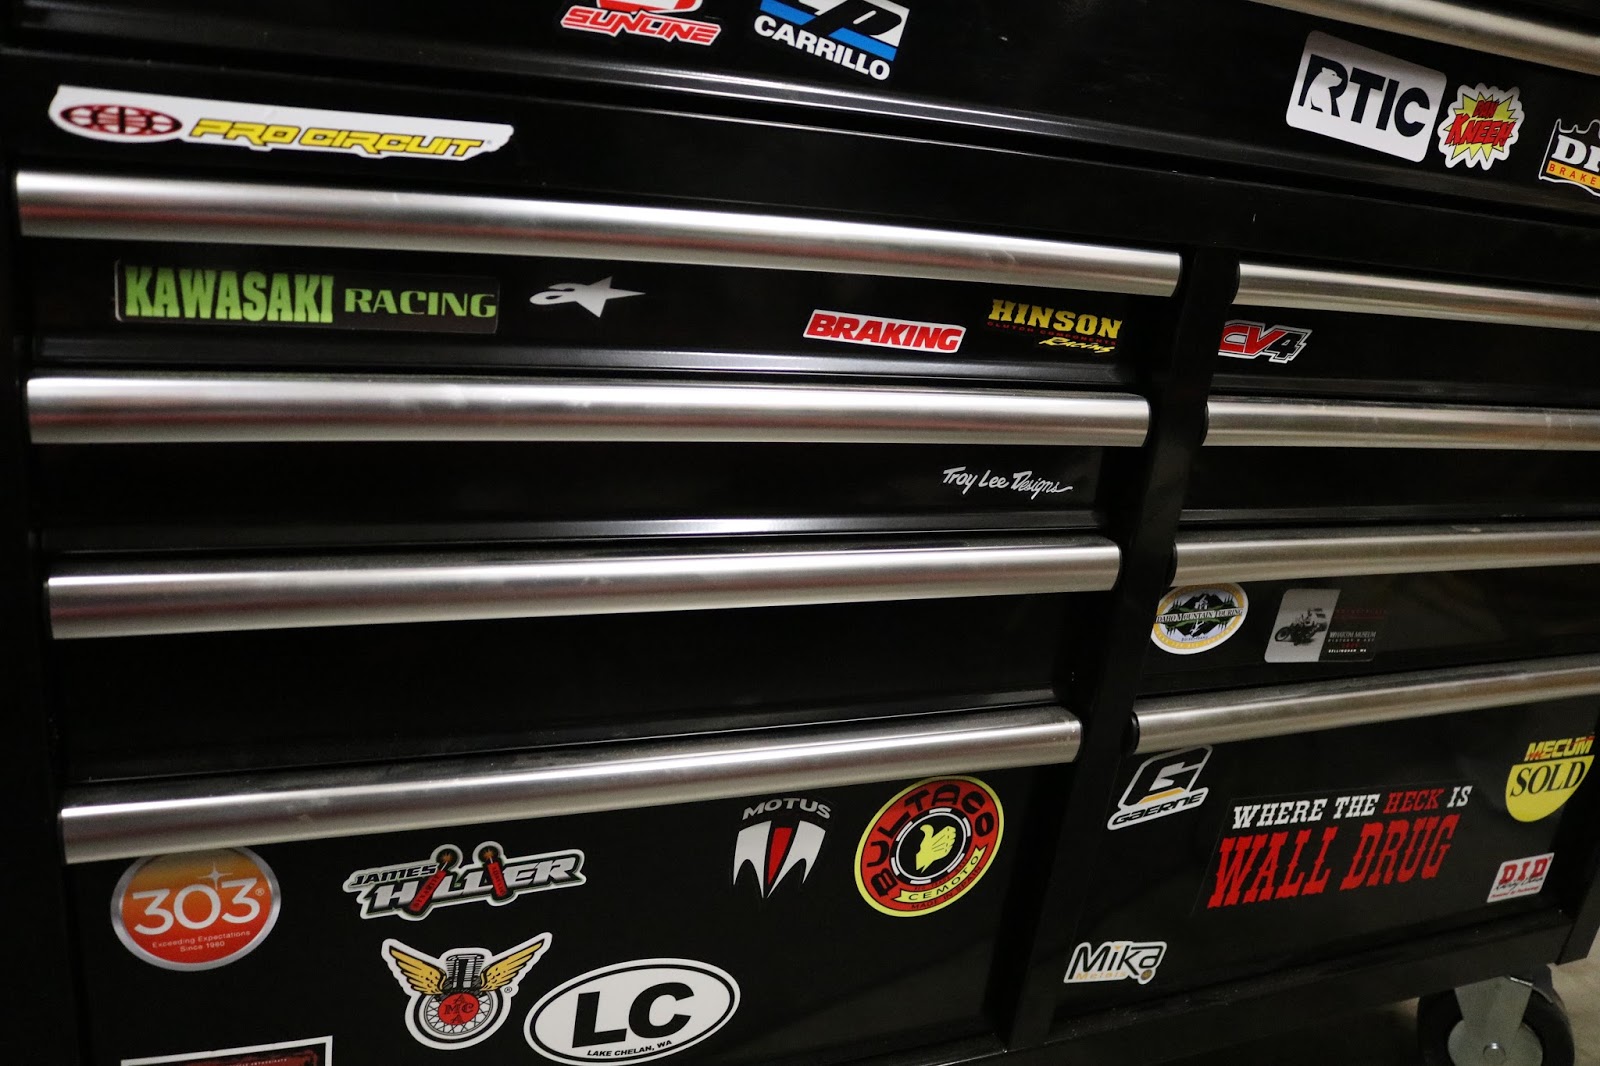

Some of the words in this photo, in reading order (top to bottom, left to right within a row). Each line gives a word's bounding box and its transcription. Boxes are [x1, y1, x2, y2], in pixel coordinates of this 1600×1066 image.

[562, 5, 722, 44] SUNLINE
[753, 14, 891, 81] CARRILLO
[1297, 53, 1431, 138] RTIC
[190, 117, 301, 146] PRO
[299, 126, 484, 157] CIRCUIT
[1444, 112, 1517, 148] KNEEN
[124, 266, 334, 324] KAWASAKI
[344, 287, 497, 318] RACING
[806, 313, 963, 351] BRAKING
[986, 320, 1035, 333] CLUTCH
[1039, 328, 1117, 346] COMPONENTS
[987, 298, 1123, 340] HINSON
[1038, 336, 1116, 354] Racing
[942, 466, 979, 495] Troy
[978, 469, 1010, 488] Lee
[1010, 470, 1074, 500] Designs
[1523, 735, 1594, 762] MECUM
[1509, 760, 1586, 798] SOLD
[741, 797, 832, 821] MOTUS
[1231, 798, 1328, 830] WHERE
[1333, 793, 1381, 820] THE
[1382, 788, 1445, 815] HECK
[1446, 785, 1473, 809] IS
[866, 783, 995, 898] BULTACO
[350, 863, 439, 887] JAMES
[908, 854, 980, 902] CEMOTO
[1206, 826, 1339, 910] WALL
[1338, 813, 1462, 892] DRUG
[132, 877, 261, 936] 303
[152, 936, 196, 949] Exceeding
[197, 930, 251, 944] Expectations
[179, 944, 203, 953] Since
[1067, 944, 1164, 980] Mika
[570, 981, 695, 1049] LC
[586, 1049, 613, 1057] LAKE
[614, 1045, 655, 1057] CHELAN,
[656, 1039, 673, 1049] WA
